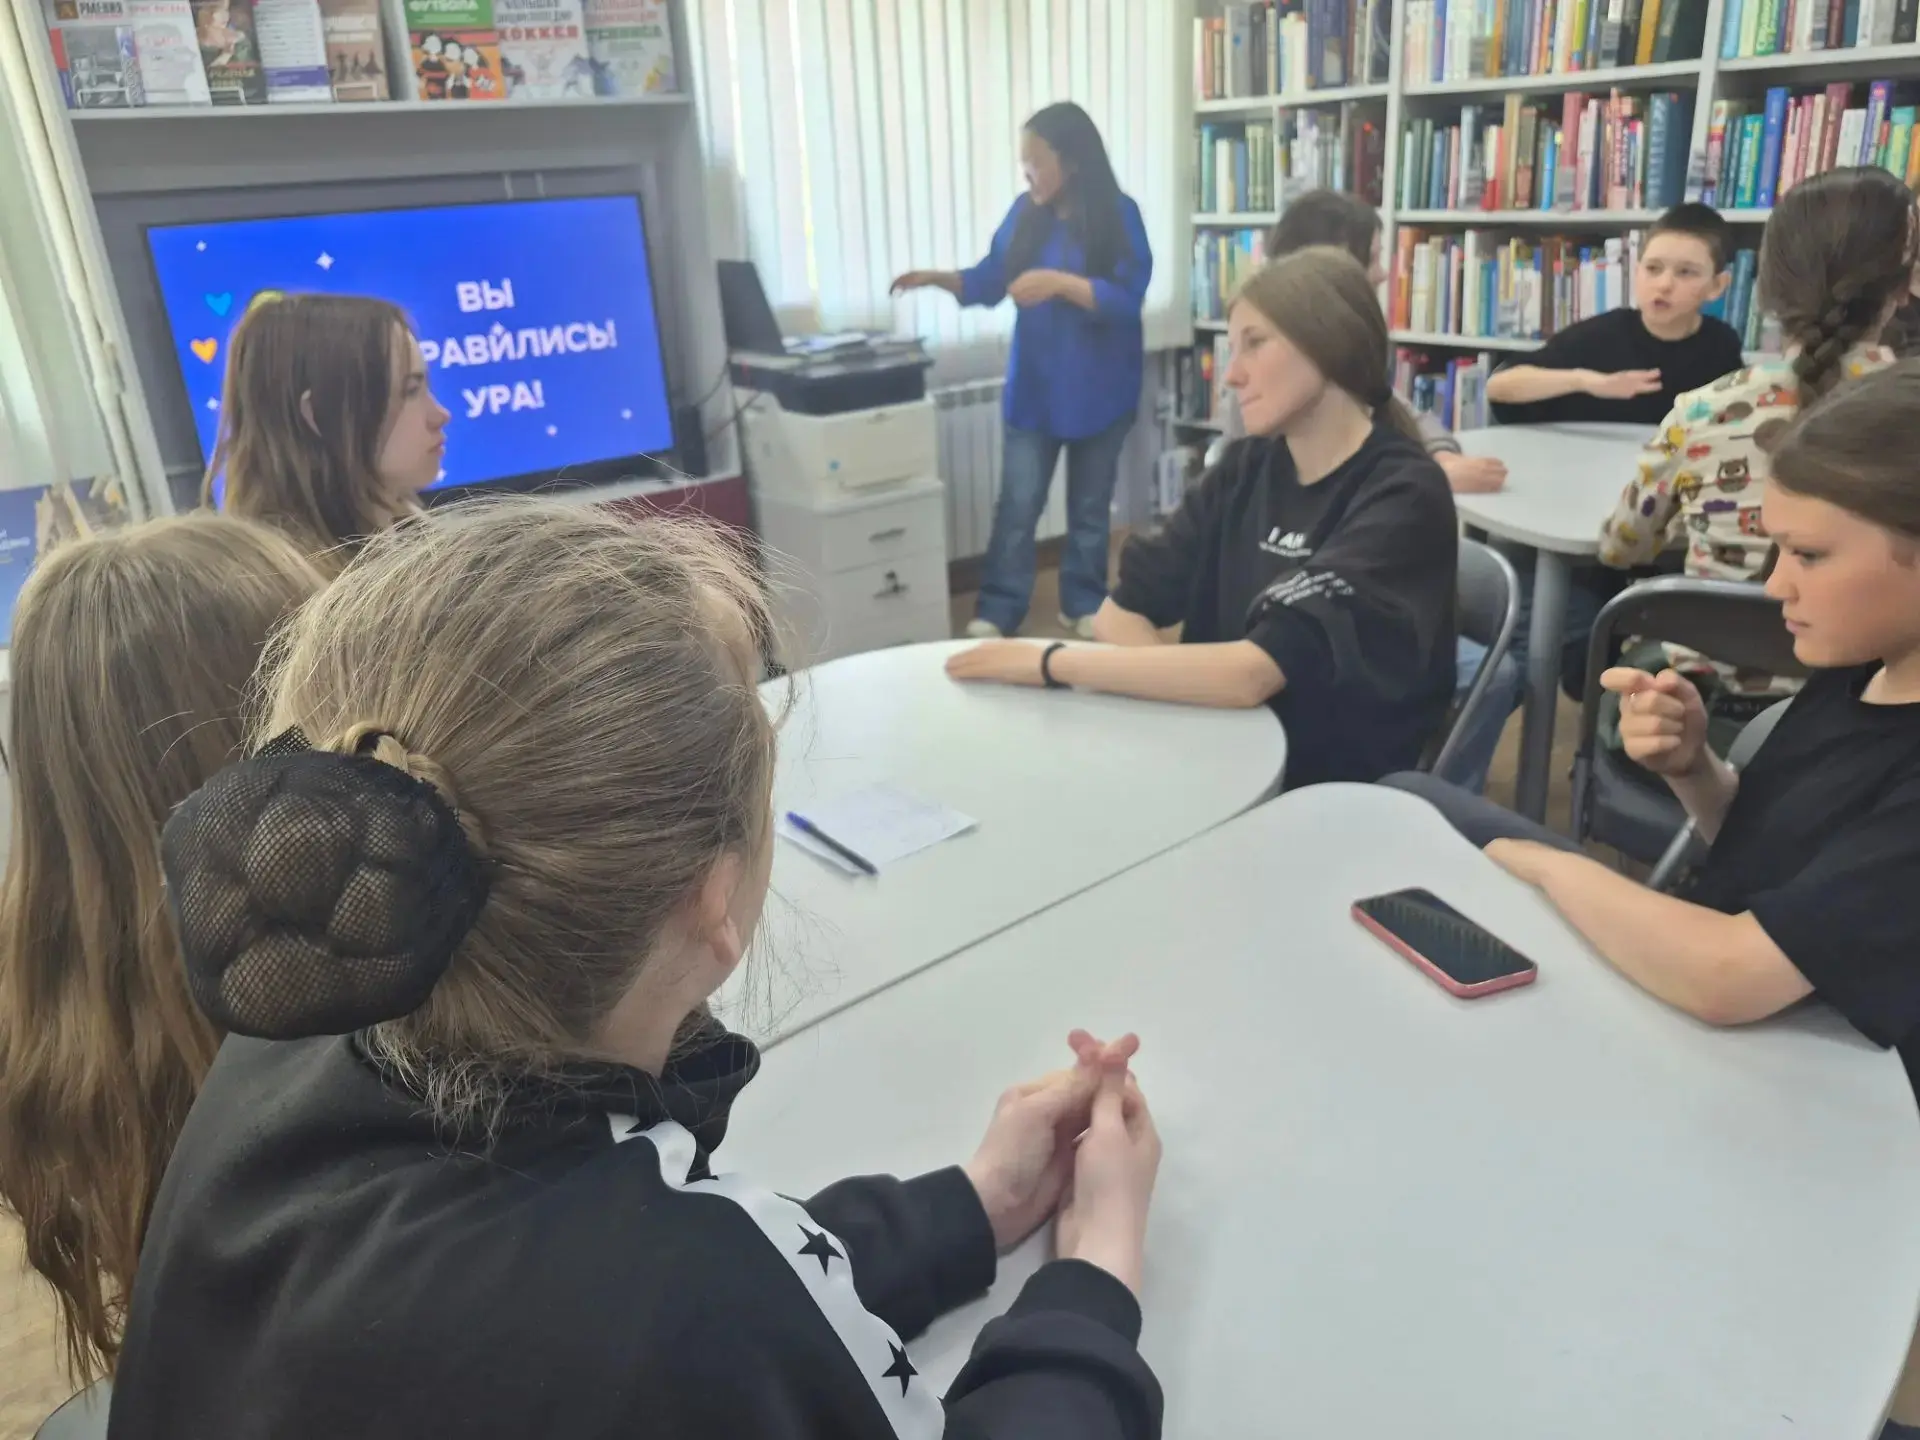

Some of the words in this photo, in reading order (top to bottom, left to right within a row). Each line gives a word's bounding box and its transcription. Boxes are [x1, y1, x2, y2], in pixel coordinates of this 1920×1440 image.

[456, 277, 515, 313] ВЫ
[418, 318, 618, 369] РАВИЛИСЬ!
[462, 379, 545, 419] УРА!
